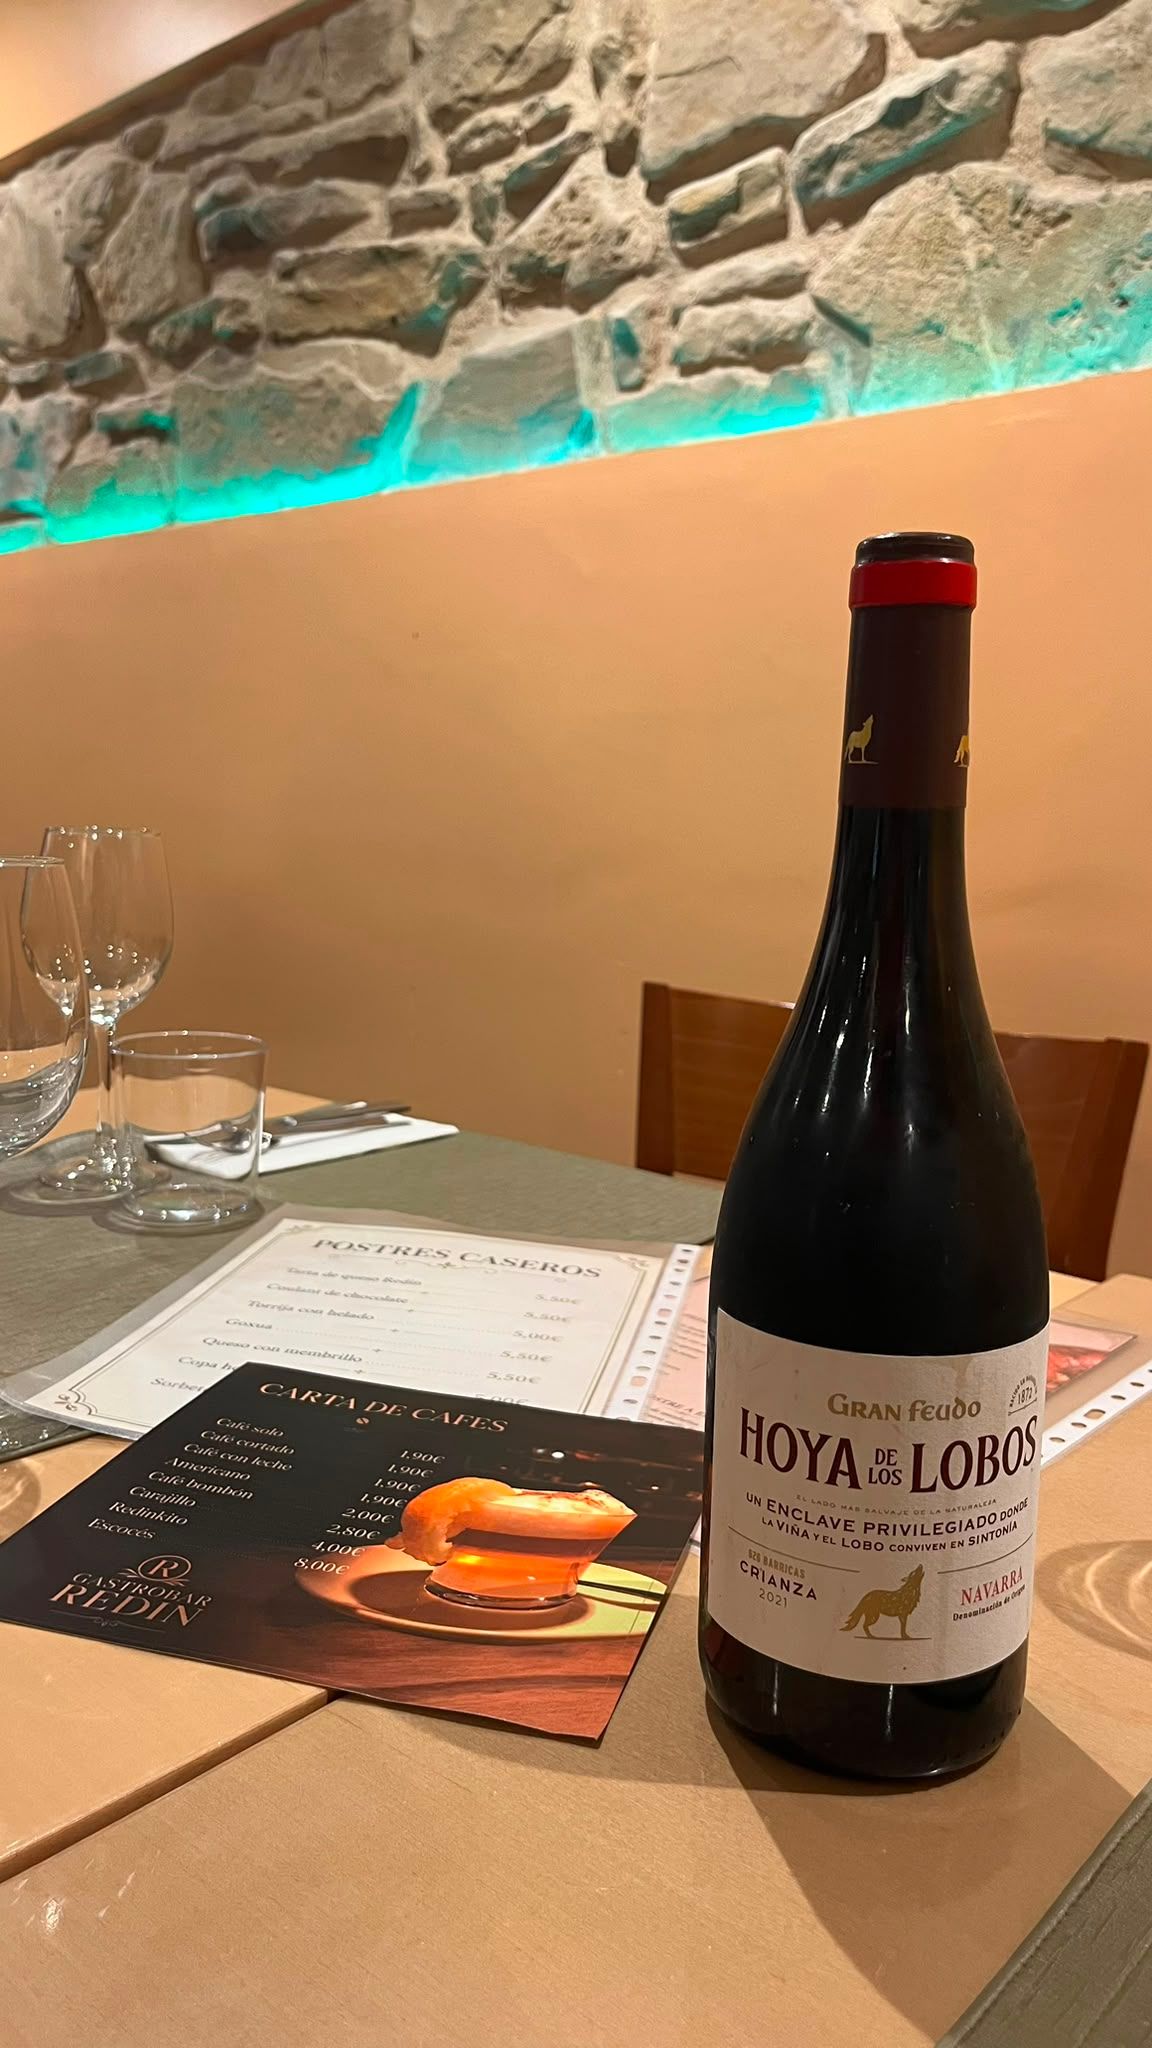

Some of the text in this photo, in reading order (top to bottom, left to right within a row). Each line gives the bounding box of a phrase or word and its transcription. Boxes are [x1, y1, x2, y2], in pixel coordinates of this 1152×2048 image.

[313, 1239, 602, 1278] POSTRES CASEROS
[266, 1282, 321, 1295] Coulant
[324, 1289, 341, 1297] de
[343, 1291, 409, 1304] chocolate
[248, 1299, 294, 1313] Torrija
[298, 1307, 324, 1316] con
[326, 1308, 375, 1320] helado
[225, 1317, 273, 1330] Goxua
[202, 1336, 250, 1349] Queso
[252, 1343, 281, 1353] con
[284, 1347, 363, 1363] membrillo
[177, 1356, 218, 1370] Copa
[259, 1382, 509, 1432] CARTA DE CAFES
[1018, 1386, 1033, 1405] 1872
[216, 1417, 250, 1431] Café
[251, 1423, 284, 1438] solo
[200, 1430, 235, 1444] Café
[236, 1438, 295, 1455] cortado
[740, 1406, 1038, 1493] HOYA DE LOS LOBOS
[164, 1456, 251, 1481] Americano
[183, 1443, 219, 1458] Café
[219, 1452, 249, 1464] con
[251, 1455, 293, 1471] leche
[128, 1485, 197, 1508] Carajillo
[148, 1470, 185, 1486] Café
[186, 1478, 254, 1500] bombón
[108, 1501, 189, 1526] Redinkito
[746, 1491, 1029, 1537] UN ENCLAVE PRIVILEGIADO DONDE
[810, 1498, 836, 1508] LADO
[864, 1507, 908, 1516] SALVAJE
[87, 1517, 157, 1539] Escocés
[761, 1516, 1018, 1552] LA VIÑA Y EL LOBO CONVIVEN EN SINTONÍA
[148, 1559, 180, 1578] R
[763, 1555, 806, 1579] BARRICAS
[72, 1572, 213, 1607] GASTROBAR
[740, 1560, 817, 1600] CRIANZA
[960, 1566, 1023, 1606] NAVARRA
[50, 1583, 204, 1627] REDIN
[759, 1587, 787, 1608] 2021
[952, 1601, 1003, 1622] Denominación
